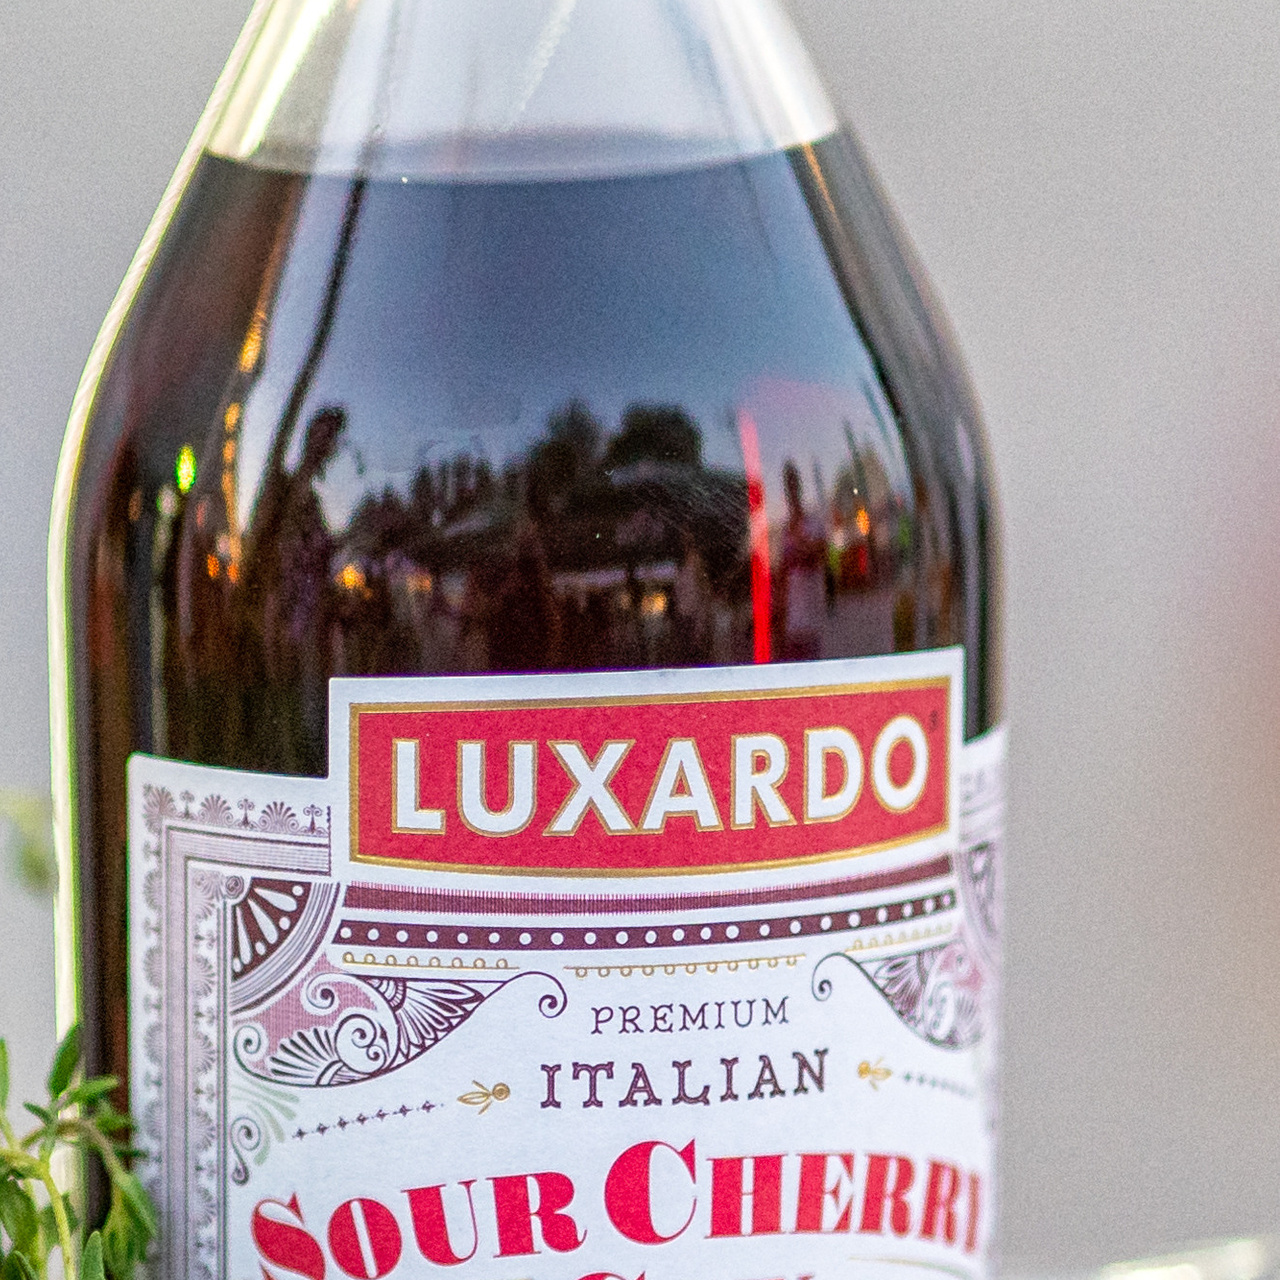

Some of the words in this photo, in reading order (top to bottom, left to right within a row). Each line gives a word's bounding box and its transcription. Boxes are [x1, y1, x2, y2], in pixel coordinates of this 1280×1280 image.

[388, 713, 930, 839] LUXARDO
[591, 996, 790, 1035] PREMIUM
[540, 1048, 830, 1109] ITALIAN
